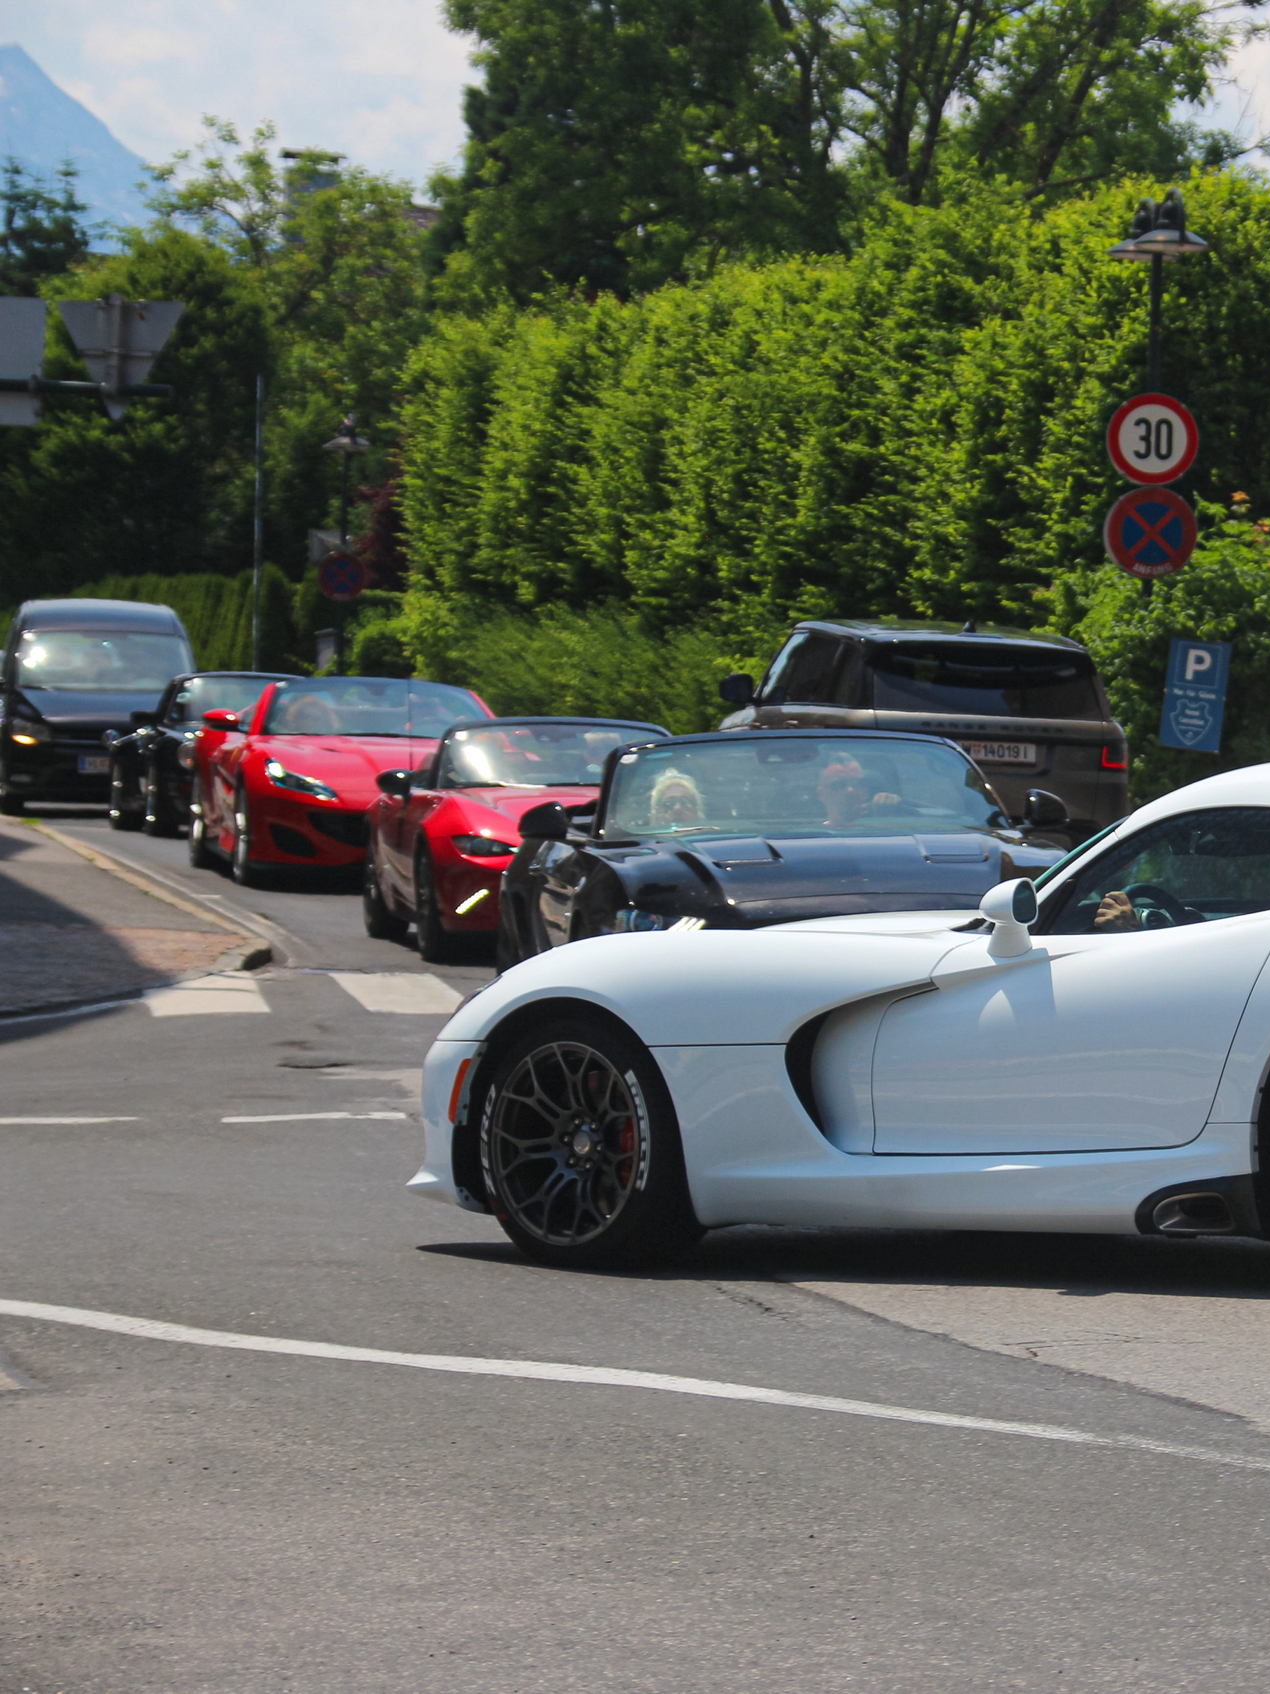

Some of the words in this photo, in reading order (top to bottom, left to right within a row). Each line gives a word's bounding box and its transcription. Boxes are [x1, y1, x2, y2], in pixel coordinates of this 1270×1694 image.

[1133, 417, 1173, 461] 30
[1132, 562, 1174, 576] ANFANG
[1185, 649, 1211, 680] P
